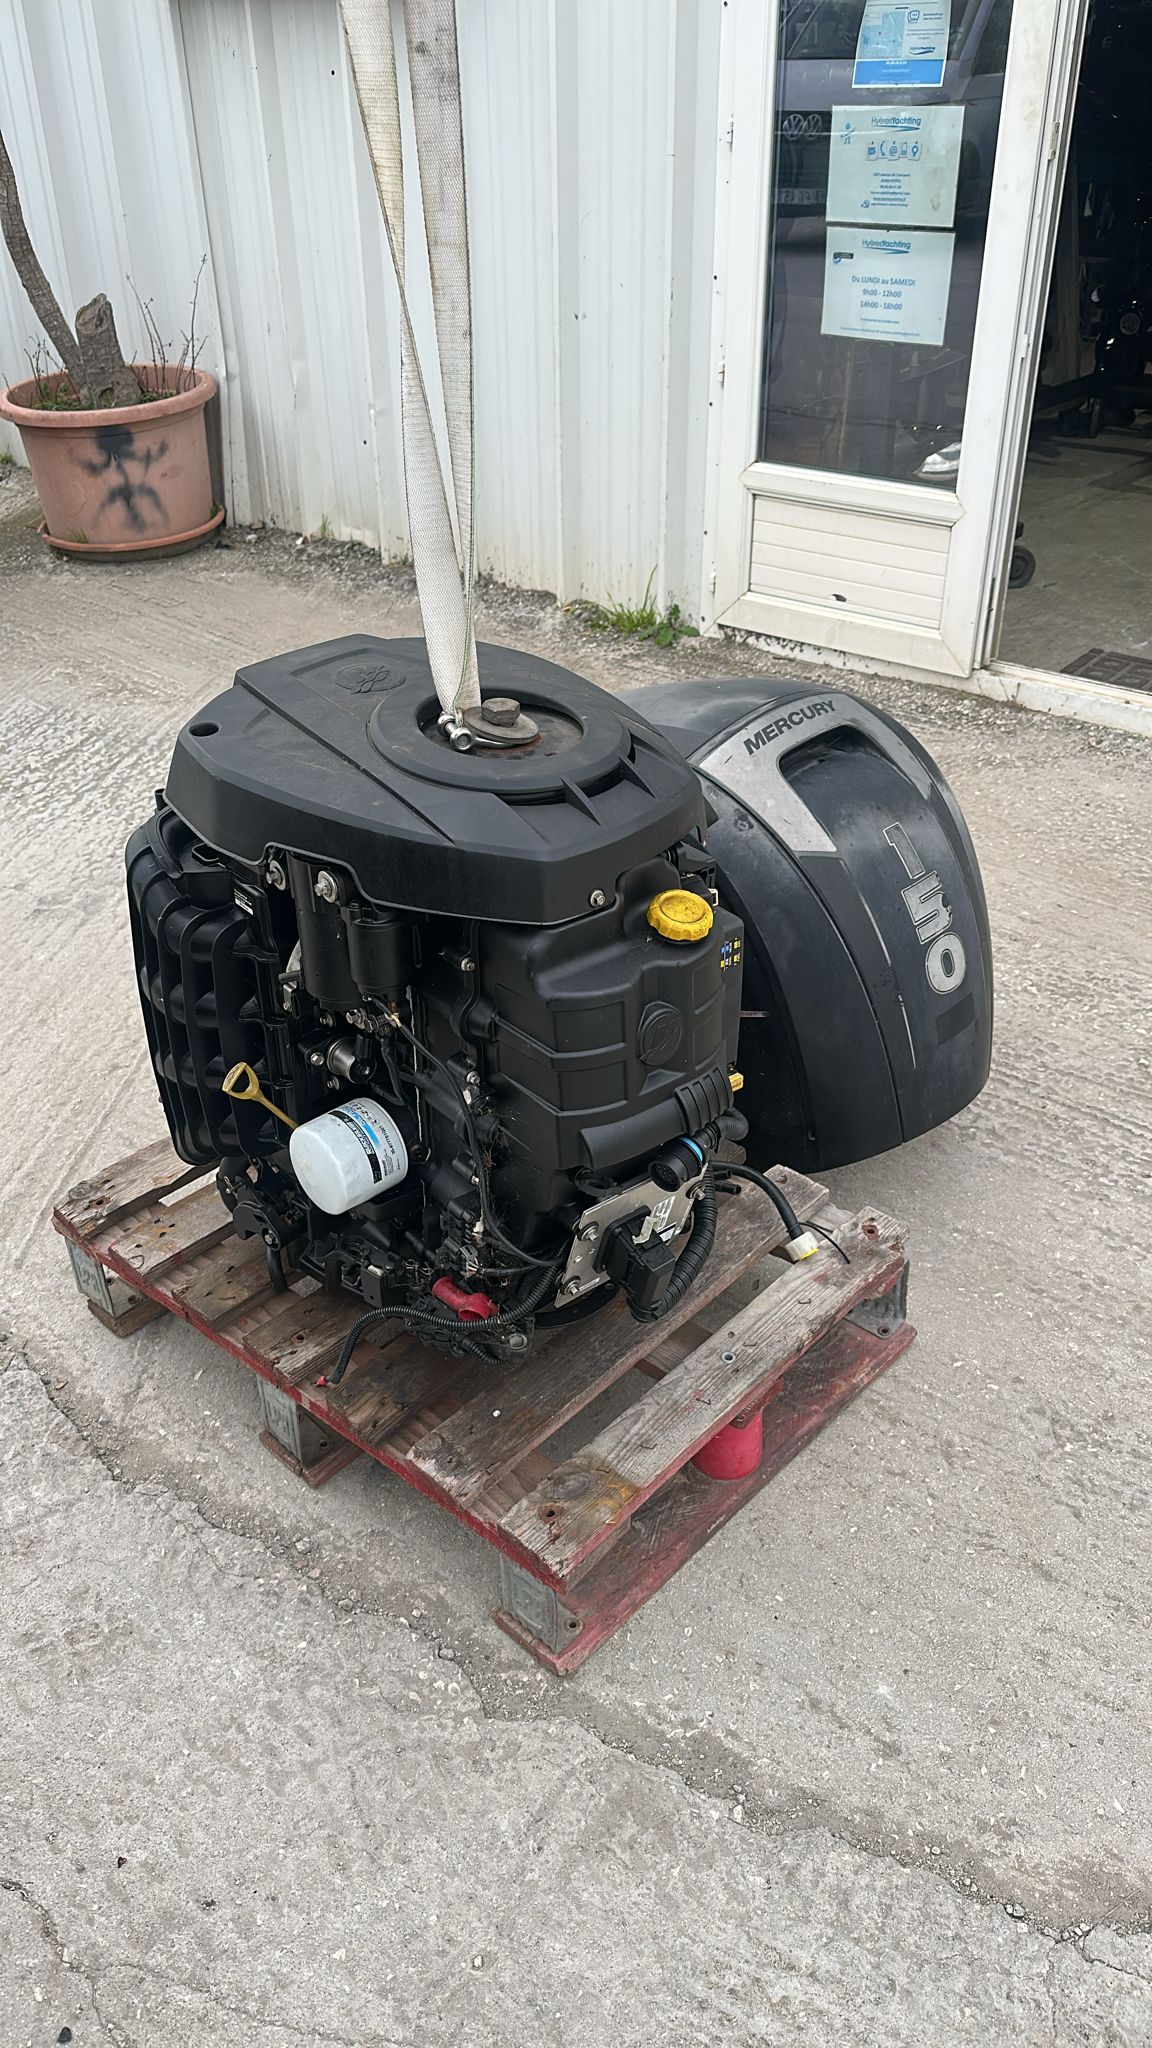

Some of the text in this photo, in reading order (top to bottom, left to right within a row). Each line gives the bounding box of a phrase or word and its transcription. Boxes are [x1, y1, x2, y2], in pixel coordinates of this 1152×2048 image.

[852, 275, 860, 283] Du
[861, 276, 880, 284] LUNDI
[890, 278, 916, 286] SAMEDI
[863, 288, 878, 296] 9h00
[882, 290, 902, 298] 12h00
[860, 301, 878, 309] 14h00
[883, 302, 903, 310] 18h00
[744, 700, 835, 756] MERCURY
[883, 822, 966, 995] 150
